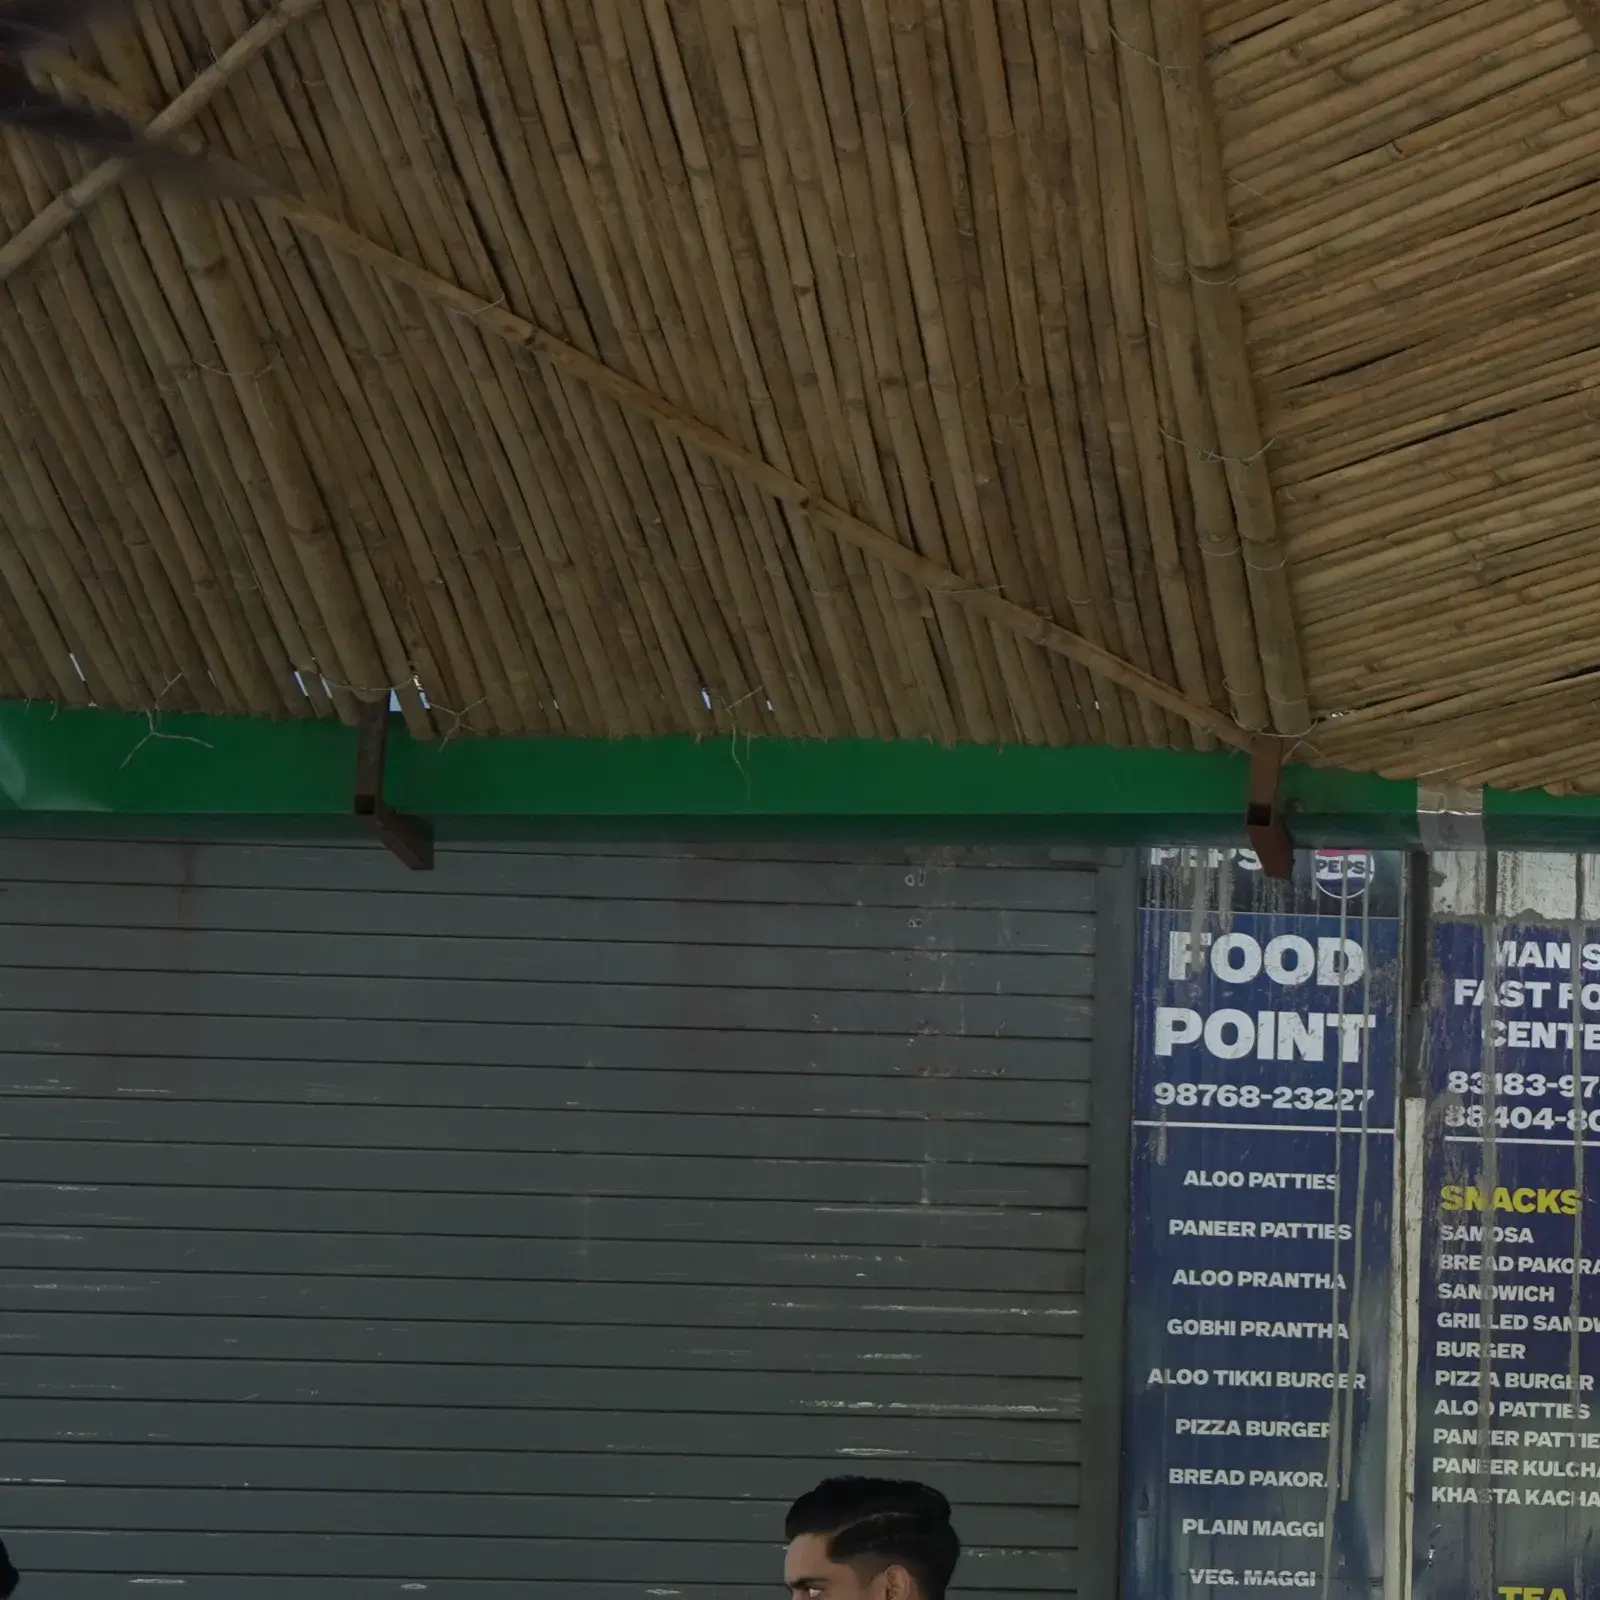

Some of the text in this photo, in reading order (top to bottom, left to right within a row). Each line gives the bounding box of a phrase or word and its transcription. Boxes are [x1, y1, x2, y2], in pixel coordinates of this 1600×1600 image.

[1168, 931, 1364, 986] FOOD
[1155, 1007, 1375, 1062] POINT
[1154, 1082, 1374, 1111] 98768-23227
[1184, 1170, 1338, 1190] ALOO PATTIES
[1440, 1184, 1584, 1215] SNACKS
[1169, 1219, 1352, 1240] PANEER PATTIES
[1440, 1225, 1535, 1244] SAMOSA
[1440, 1254, 1514, 1272] BREAD
[1172, 1269, 1347, 1289] ALOO PRANTHA
[1167, 1319, 1349, 1339] GOBHI PRANTHA
[1436, 1312, 1529, 1330] GRILLED
[1436, 1341, 1526, 1360] BURGER
[1147, 1368, 1366, 1390] ALOO TIKKI BURGER
[1435, 1370, 1595, 1391] PIZZA BURGER
[1499, 1401, 1591, 1420] PATTIES
[1176, 1418, 1241, 1436] PIZZA
[1169, 1468, 1245, 1485] BREAD
[1183, 1518, 1324, 1538] PLAIN MAGGI
[1189, 1568, 1316, 1587] VEG. MAGGI
